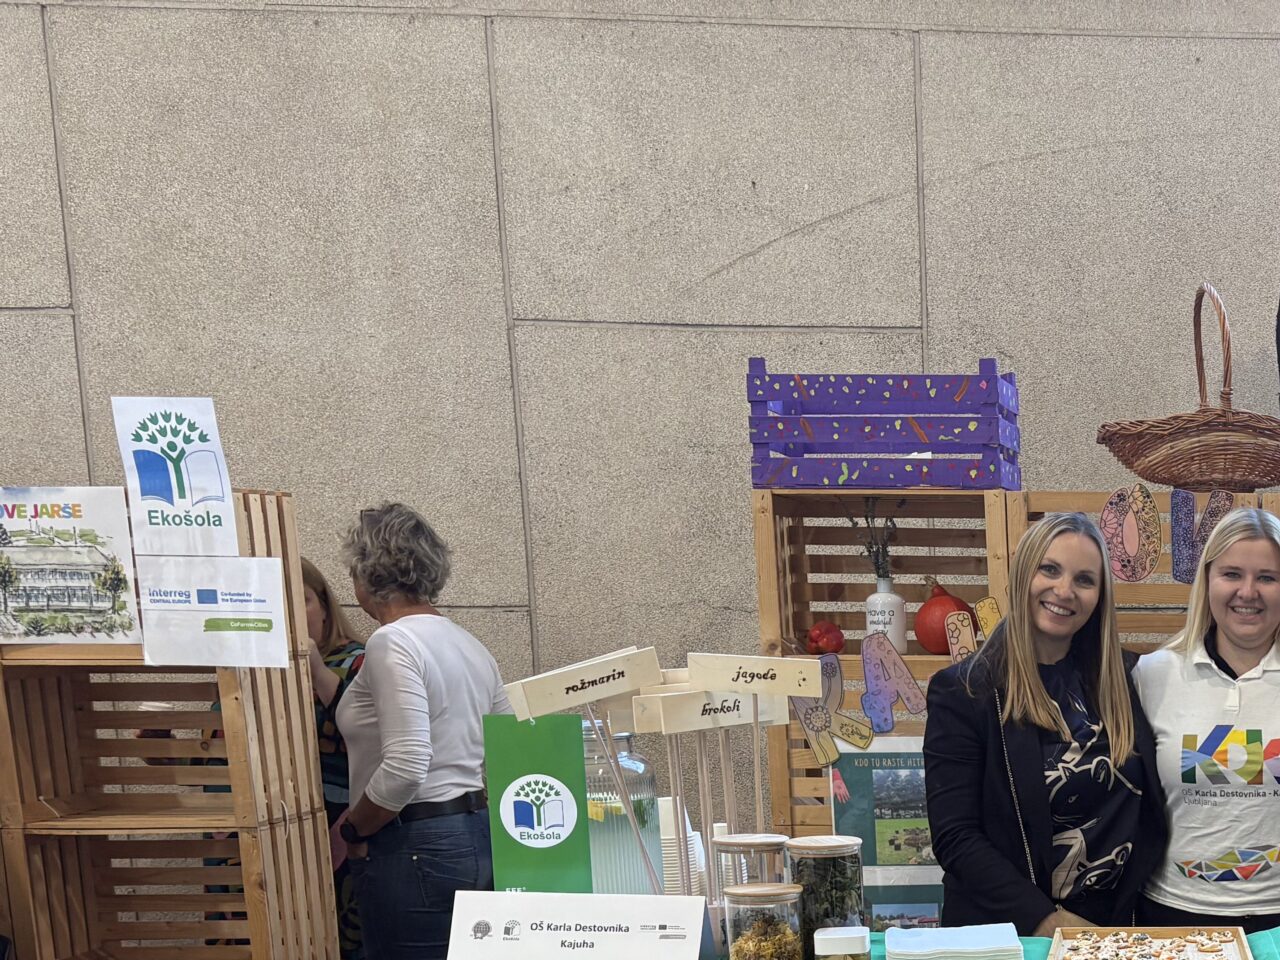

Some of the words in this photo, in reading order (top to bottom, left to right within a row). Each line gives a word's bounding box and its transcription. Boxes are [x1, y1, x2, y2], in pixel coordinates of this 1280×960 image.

[31, 503, 83, 519] JARŠE
[148, 509, 223, 528] Ekošola
[732, 666, 777, 683] jagode
[565, 669, 626, 695] rožmarin
[701, 699, 741, 717] brokoli
[883, 758, 905, 767] RASTE
[1195, 789, 1217, 798] Karla
[1220, 790, 1266, 799] Destovnika
[519, 831, 561, 841] Ekošola
[530, 920, 544, 931] OŠ
[546, 922, 572, 933] Karla
[574, 923, 630, 933] Destovnika
[561, 940, 595, 950] Kajuha
